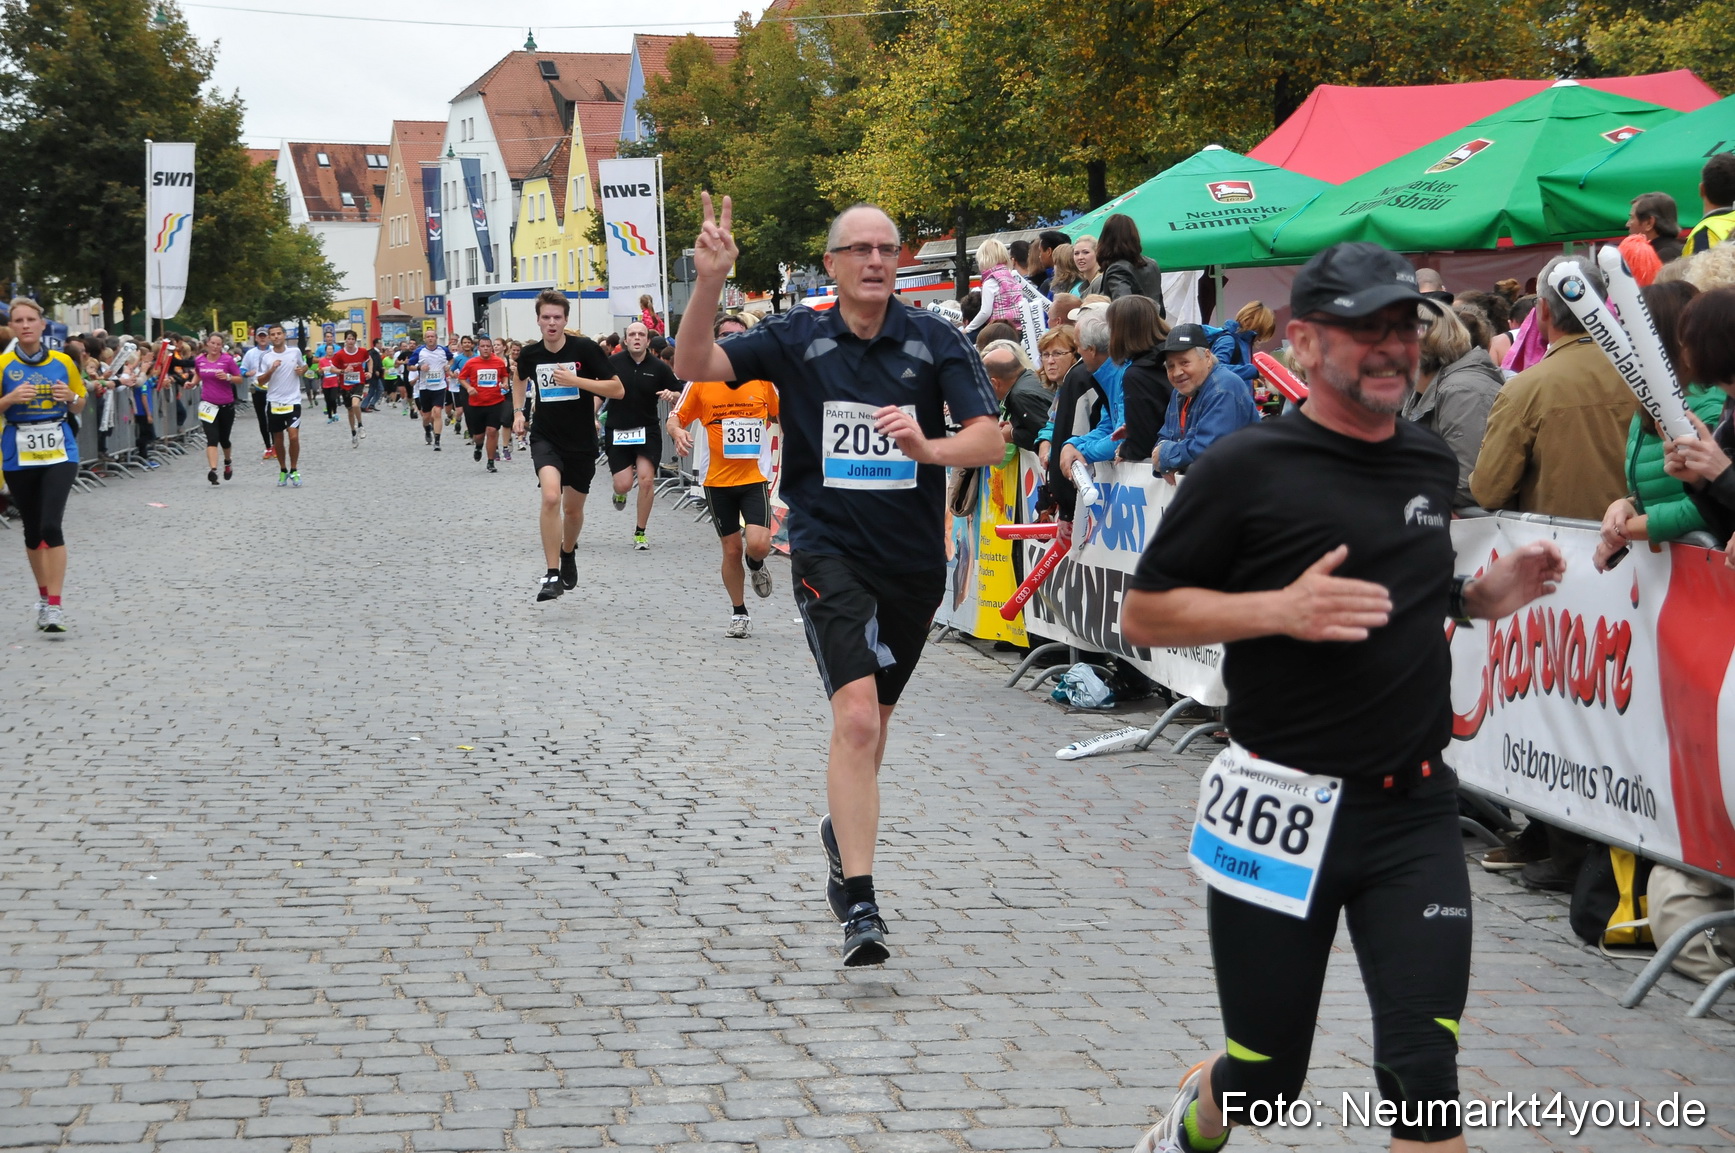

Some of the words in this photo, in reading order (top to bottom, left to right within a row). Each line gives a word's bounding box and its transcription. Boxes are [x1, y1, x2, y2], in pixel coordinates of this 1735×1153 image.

[153, 171, 194, 187] swn
[1186, 205, 1288, 219] Neumarkte
[236, 327, 244, 338] D
[825, 409, 856, 420] PARTL
[27, 433, 56, 449] 316
[727, 427, 761, 443] 3319
[847, 464, 892, 478] Johann
[1416, 511, 1444, 527] Frank
[1043, 550, 1059, 570] Audi
[1031, 567, 1047, 584] BKK
[1240, 766, 1309, 798] Neumarkt
[1502, 732, 1598, 800] Ostbayerns
[1605, 764, 1657, 821] Radio
[1203, 773, 1314, 856] 2468
[1214, 845, 1262, 881] Frank
[1440, 906, 1468, 917] asics
